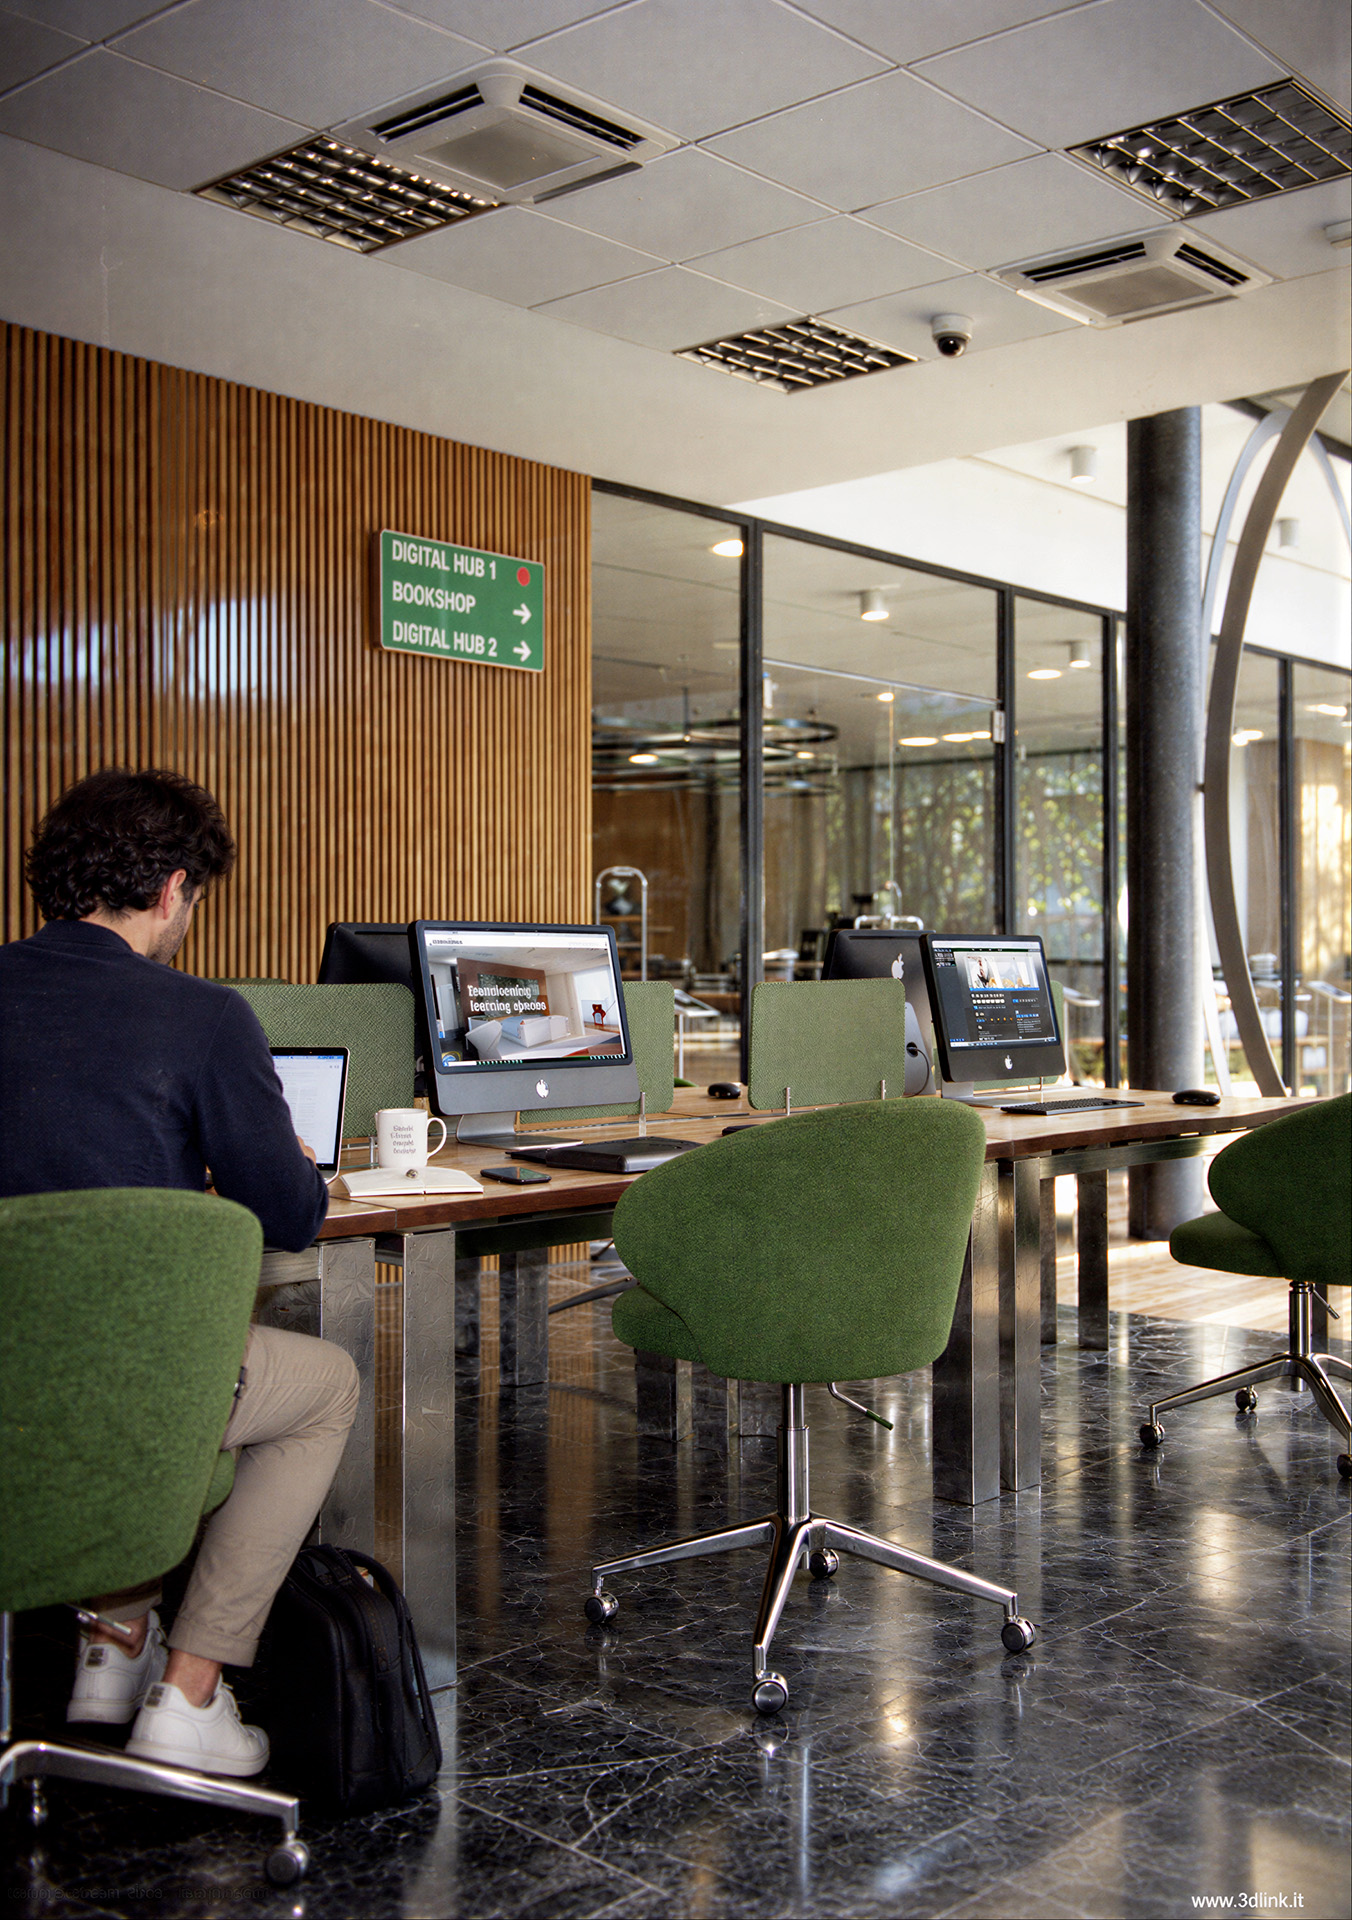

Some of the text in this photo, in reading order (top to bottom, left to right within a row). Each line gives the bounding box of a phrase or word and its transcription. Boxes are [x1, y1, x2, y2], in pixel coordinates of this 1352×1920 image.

[392, 539, 497, 580] DIGITAL HUB 1
[392, 580, 476, 614] BOOKSHOP
[392, 620, 498, 657] DIGITAL HUB 2
